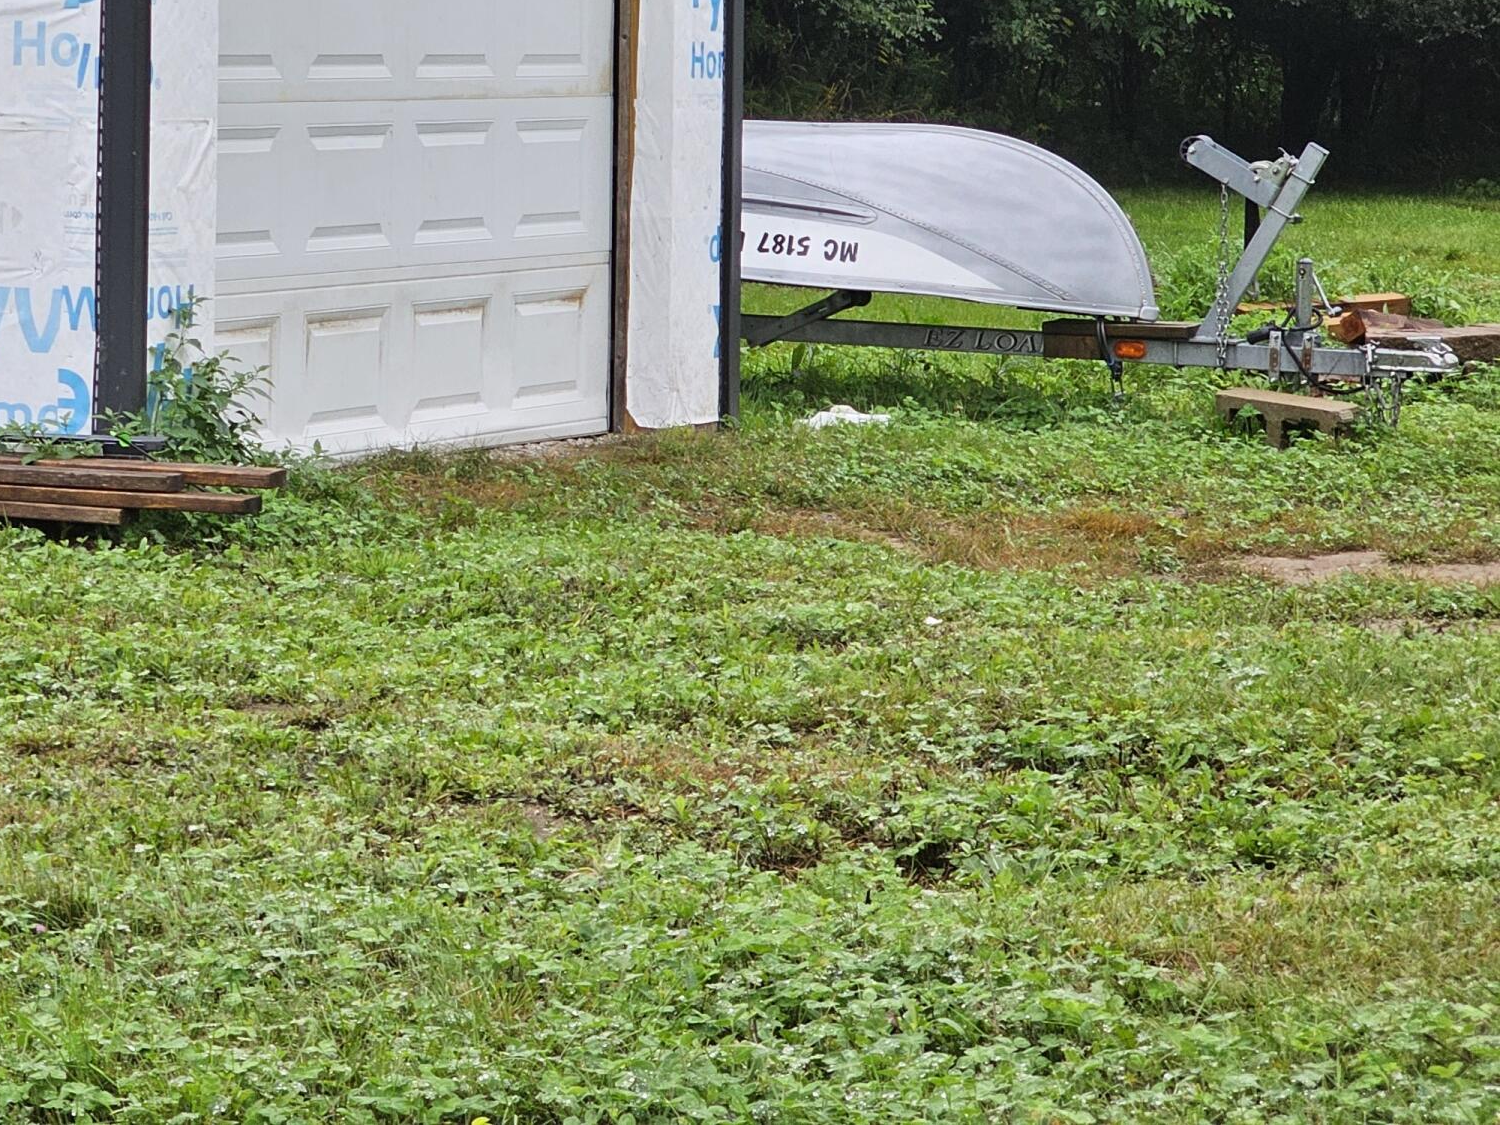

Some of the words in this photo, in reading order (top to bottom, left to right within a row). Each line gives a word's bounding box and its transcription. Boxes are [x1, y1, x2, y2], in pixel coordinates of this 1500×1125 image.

[756, 232, 811, 257] 5187
[823, 239, 859, 263] MC
[923, 328, 966, 349] EZ
[974, 330, 1043, 354] LOA
